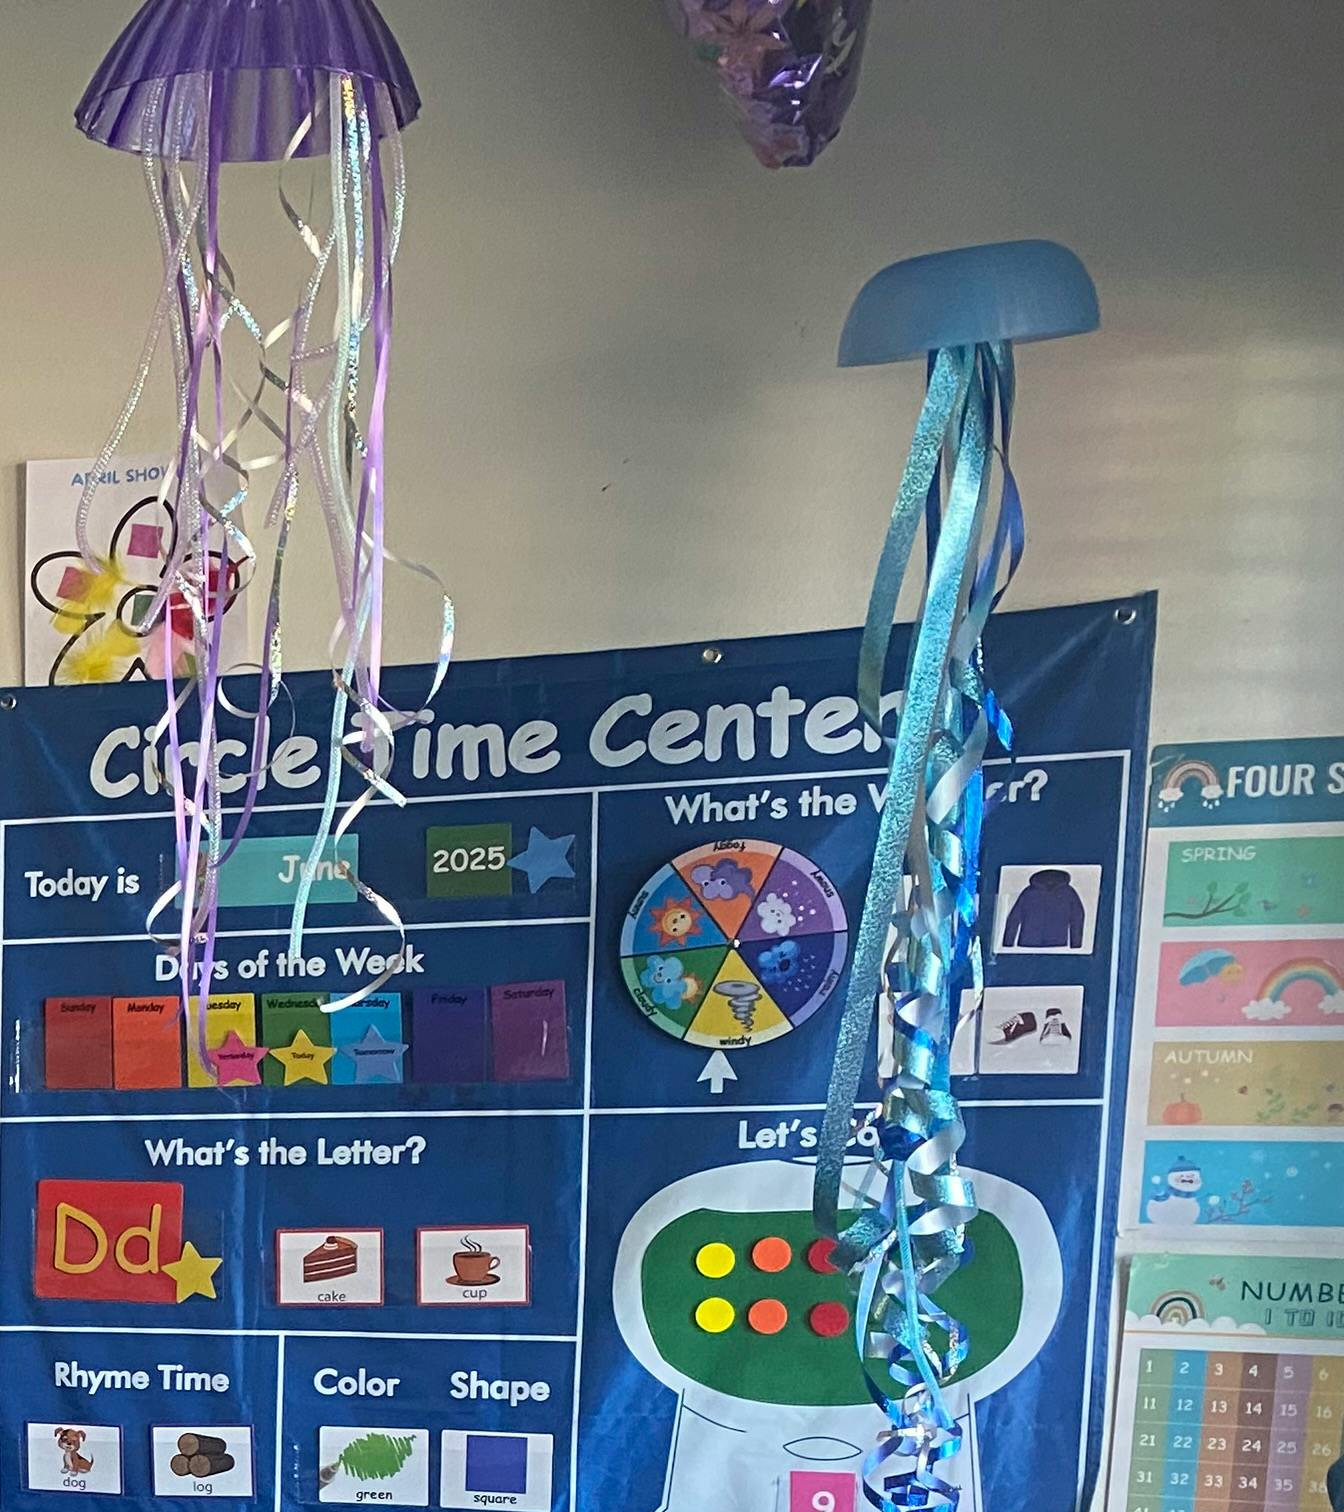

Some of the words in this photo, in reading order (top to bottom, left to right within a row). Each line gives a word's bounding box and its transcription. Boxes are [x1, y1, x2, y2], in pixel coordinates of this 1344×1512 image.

[90, 714, 321, 800] Circle
[351, 708, 561, 783] Time
[590, 685, 904, 768] Center
[1226, 763, 1316, 799] FOUR
[664, 787, 789, 826] What's
[798, 785, 858, 817] the
[433, 846, 506, 875] 2025
[1181, 846, 1257, 864] SPRING
[277, 855, 351, 884] June
[25, 868, 109, 902] Today
[116, 868, 141, 895] is
[238, 949, 269, 978] of
[276, 952, 326, 977] the
[335, 943, 425, 976] Week
[430, 993, 468, 1006] Friday
[503, 987, 555, 1001] Saturday
[127, 1002, 165, 1014] Monday
[206, 999, 242, 1011] uesday
[719, 1036, 752, 1047] windy
[1163, 1048, 1254, 1066] AUTUMN
[738, 1118, 818, 1150] Let's
[144, 1136, 250, 1168] What's
[258, 1138, 307, 1166] the
[318, 1135, 427, 1167] Letter?
[54, 1200, 163, 1276] Dd
[317, 1288, 347, 1303] cake
[462, 1287, 489, 1302] cup
[1145, 1359, 1153, 1373] 1
[1179, 1361, 1190, 1375] 2
[1214, 1363, 1224, 1376] 3
[1249, 1364, 1258, 1377] 4
[53, 1361, 150, 1396] Rhyme
[157, 1364, 231, 1394] Time
[313, 1367, 401, 1399] Color
[449, 1370, 551, 1407] Shape
[1143, 1396, 1157, 1410] 11
[1177, 1398, 1193, 1411] 12
[1211, 1400, 1228, 1414] 13
[1245, 1402, 1262, 1415] 14
[1139, 1434, 1156, 1447] 21
[1173, 1436, 1193, 1449] 22
[1207, 1437, 1227, 1451] 23
[1241, 1439, 1261, 1452] 24
[62, 1475, 88, 1492] dog
[1136, 1470, 1153, 1484] 31
[1170, 1472, 1189, 1485] 32
[1204, 1474, 1224, 1487] 33
[192, 1479, 214, 1496] log
[355, 1488, 394, 1504] green
[473, 1492, 518, 1508] square
